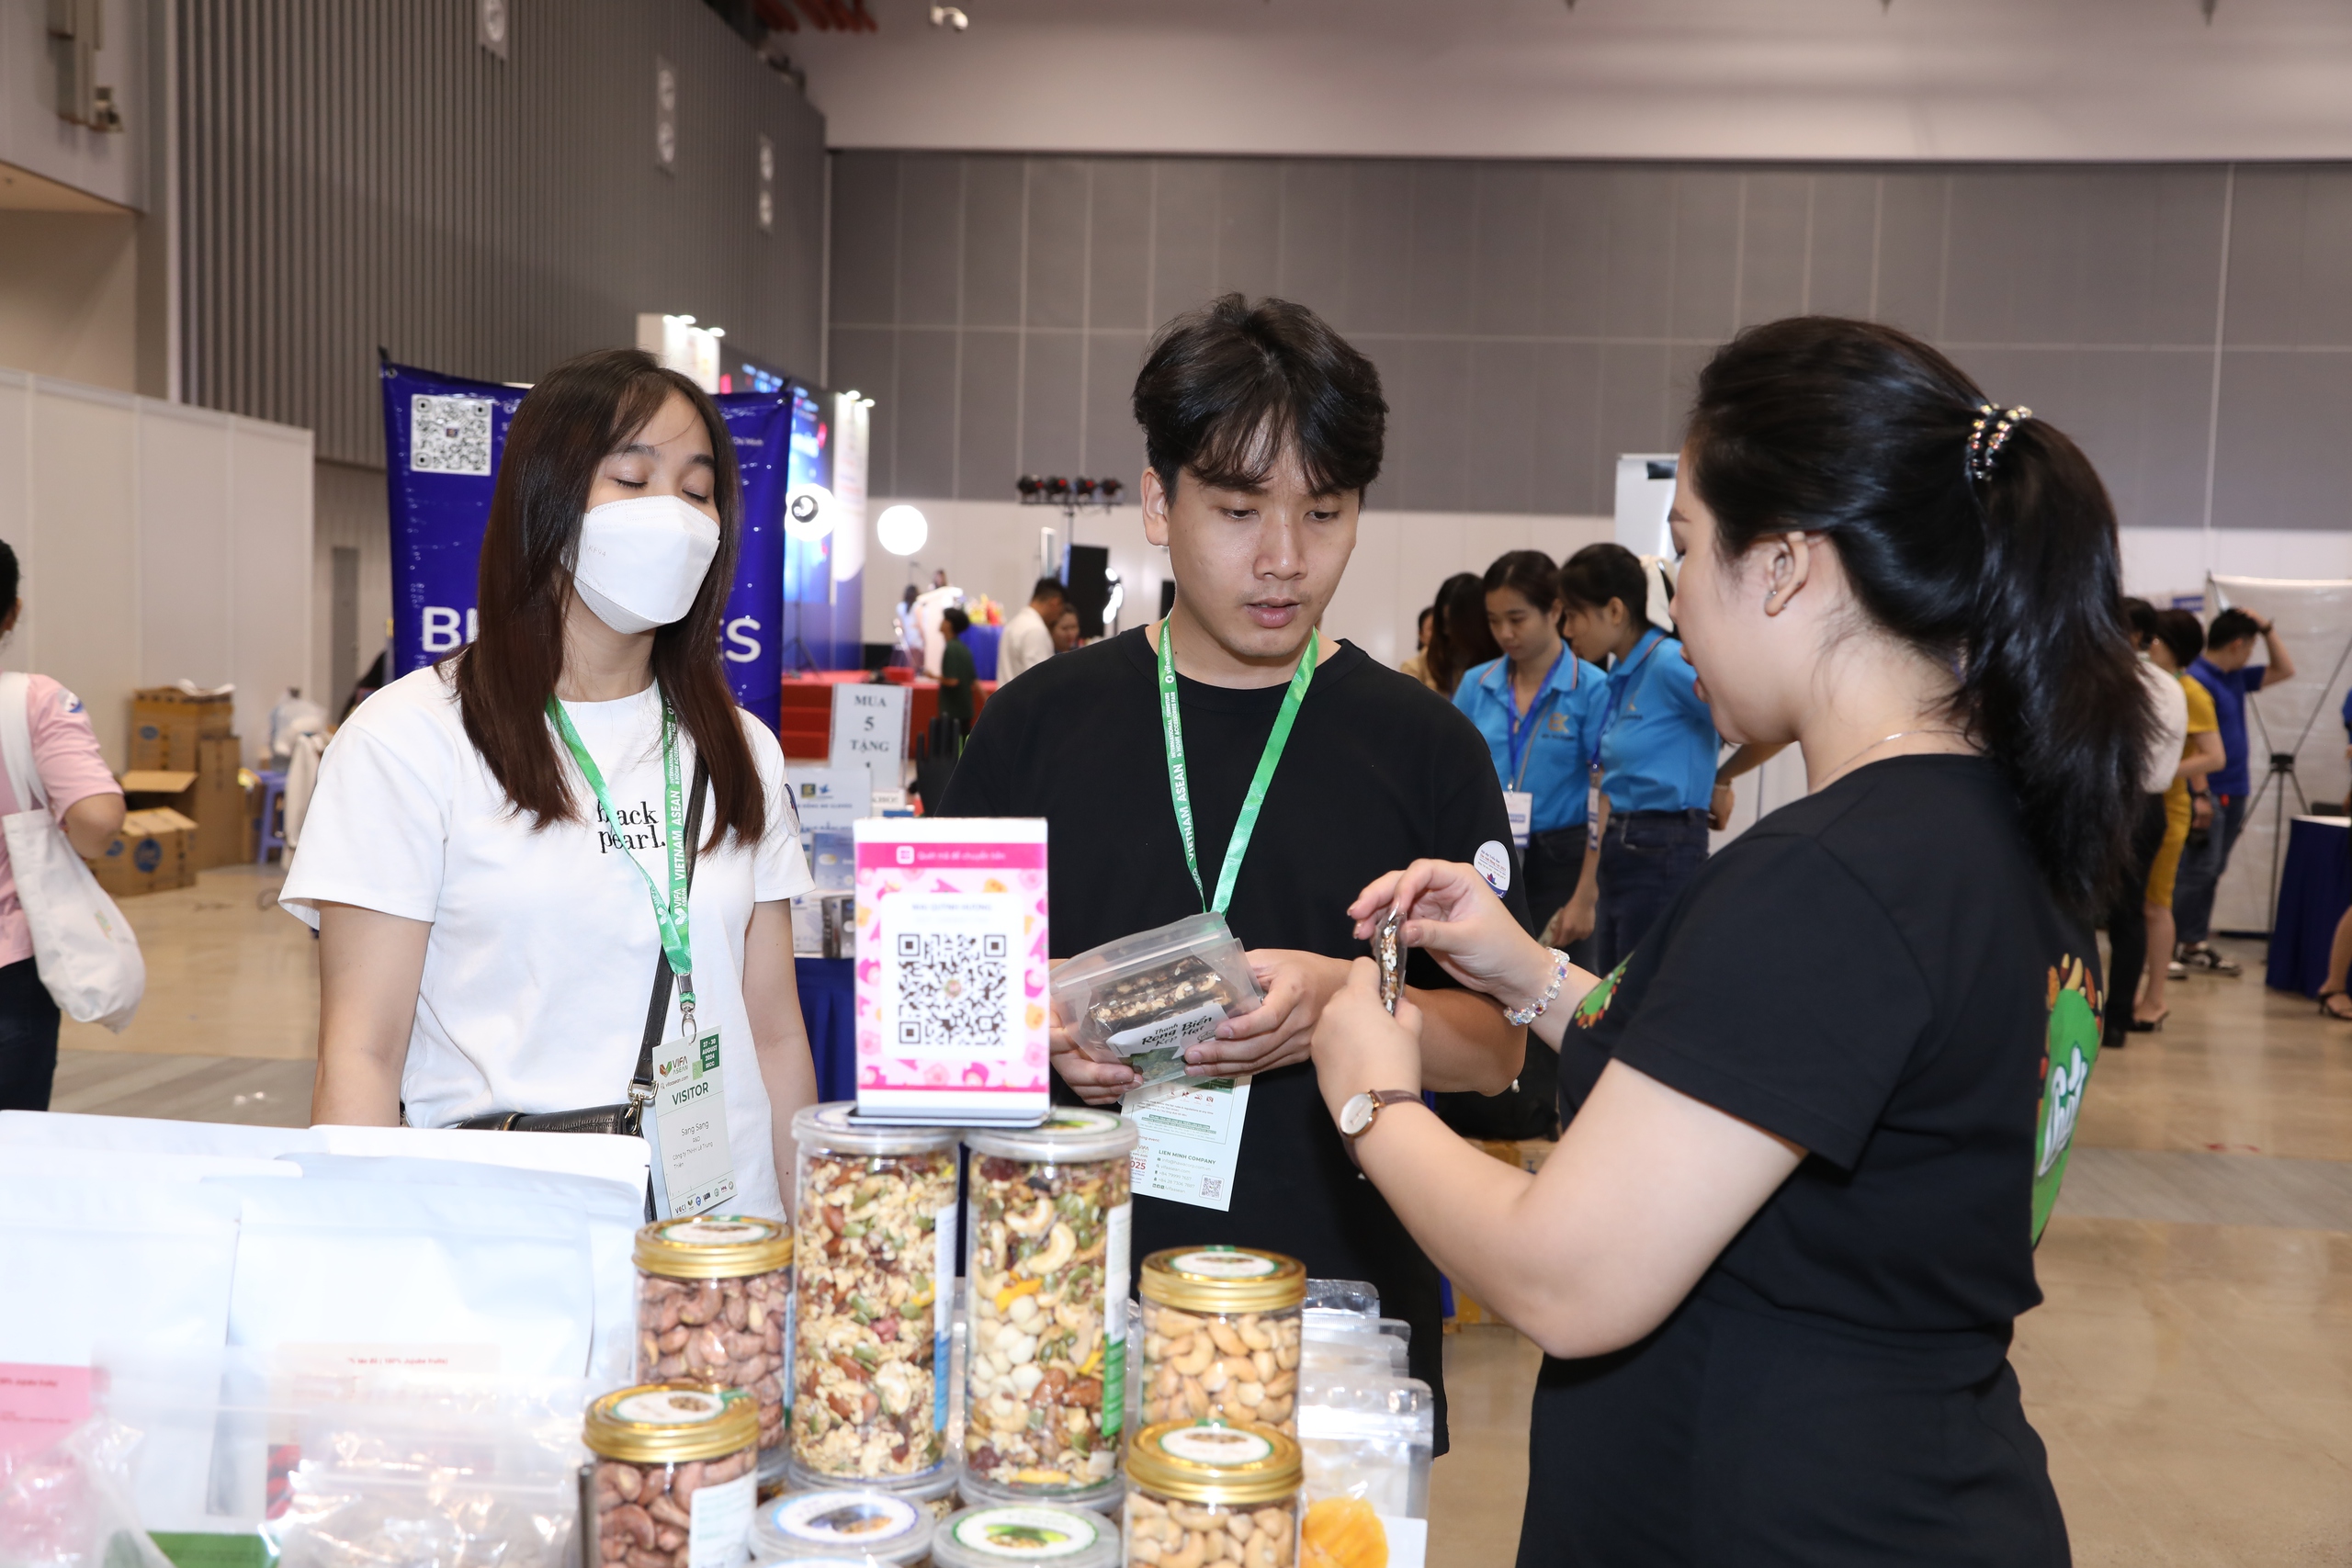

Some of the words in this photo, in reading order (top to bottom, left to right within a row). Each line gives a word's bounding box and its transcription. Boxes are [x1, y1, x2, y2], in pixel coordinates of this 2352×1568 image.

[854, 694, 887, 707] MUA
[864, 716, 875, 731] 5
[1170, 703, 1180, 735] ACCESSORIES
[1167, 719, 1177, 759] INTERNATIONAL
[1174, 736, 1182, 752] HOME
[1173, 763, 1187, 802] ASEAN
[597, 798, 659, 826] back
[671, 790, 682, 826] ASEAN
[1179, 807, 1194, 862] VIETNAM
[673, 830, 685, 881] VIETNAM
[673, 888, 682, 908] VIFA
[1142, 1030, 1176, 1045] Rong
[1182, 1015, 1213, 1032] Biển
[1156, 1022, 1178, 1035] Thanh
[702, 1045, 718, 1055] AUGUST
[672, 1055, 688, 1068] VIFA
[673, 1065, 688, 1076] ASEAN
[665, 1075, 689, 1088] vifaasean.com
[672, 1082, 709, 1105] VISITOR
[681, 1126, 695, 1136] Sang
[695, 1121, 709, 1131] Sang
[1188, 1156, 1216, 1165] COMPANY
